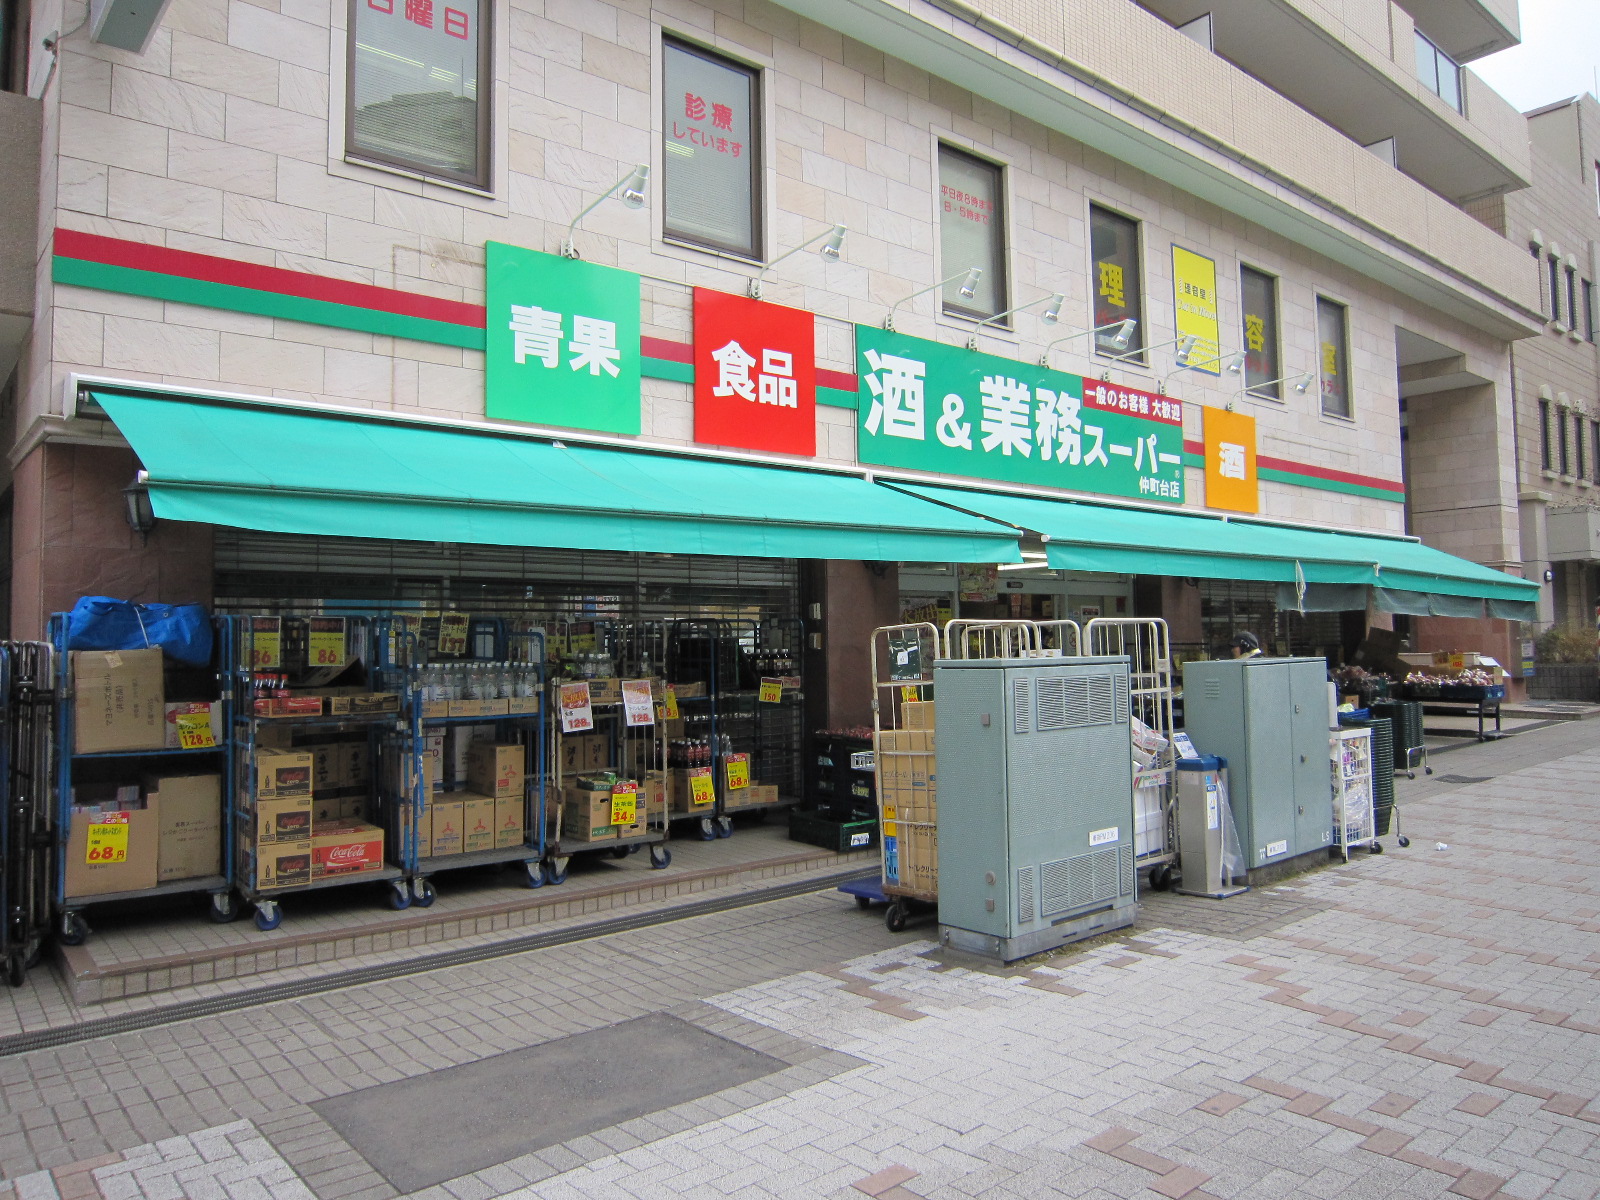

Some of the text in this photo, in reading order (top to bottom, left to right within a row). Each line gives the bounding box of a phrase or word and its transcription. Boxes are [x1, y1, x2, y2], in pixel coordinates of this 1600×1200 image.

[685, 92, 733, 132] 診療
[673, 121, 743, 158] しています
[1098, 261, 1126, 308] 理
[509, 304, 620, 378] 青果
[1245, 313, 1265, 352] 容
[711, 340, 798, 409] 食品
[1084, 385, 1181, 422] 一般のお客様 大歓迎
[1219, 442, 1246, 480] 酒
[1139, 475, 1180, 498] 仲町台店
